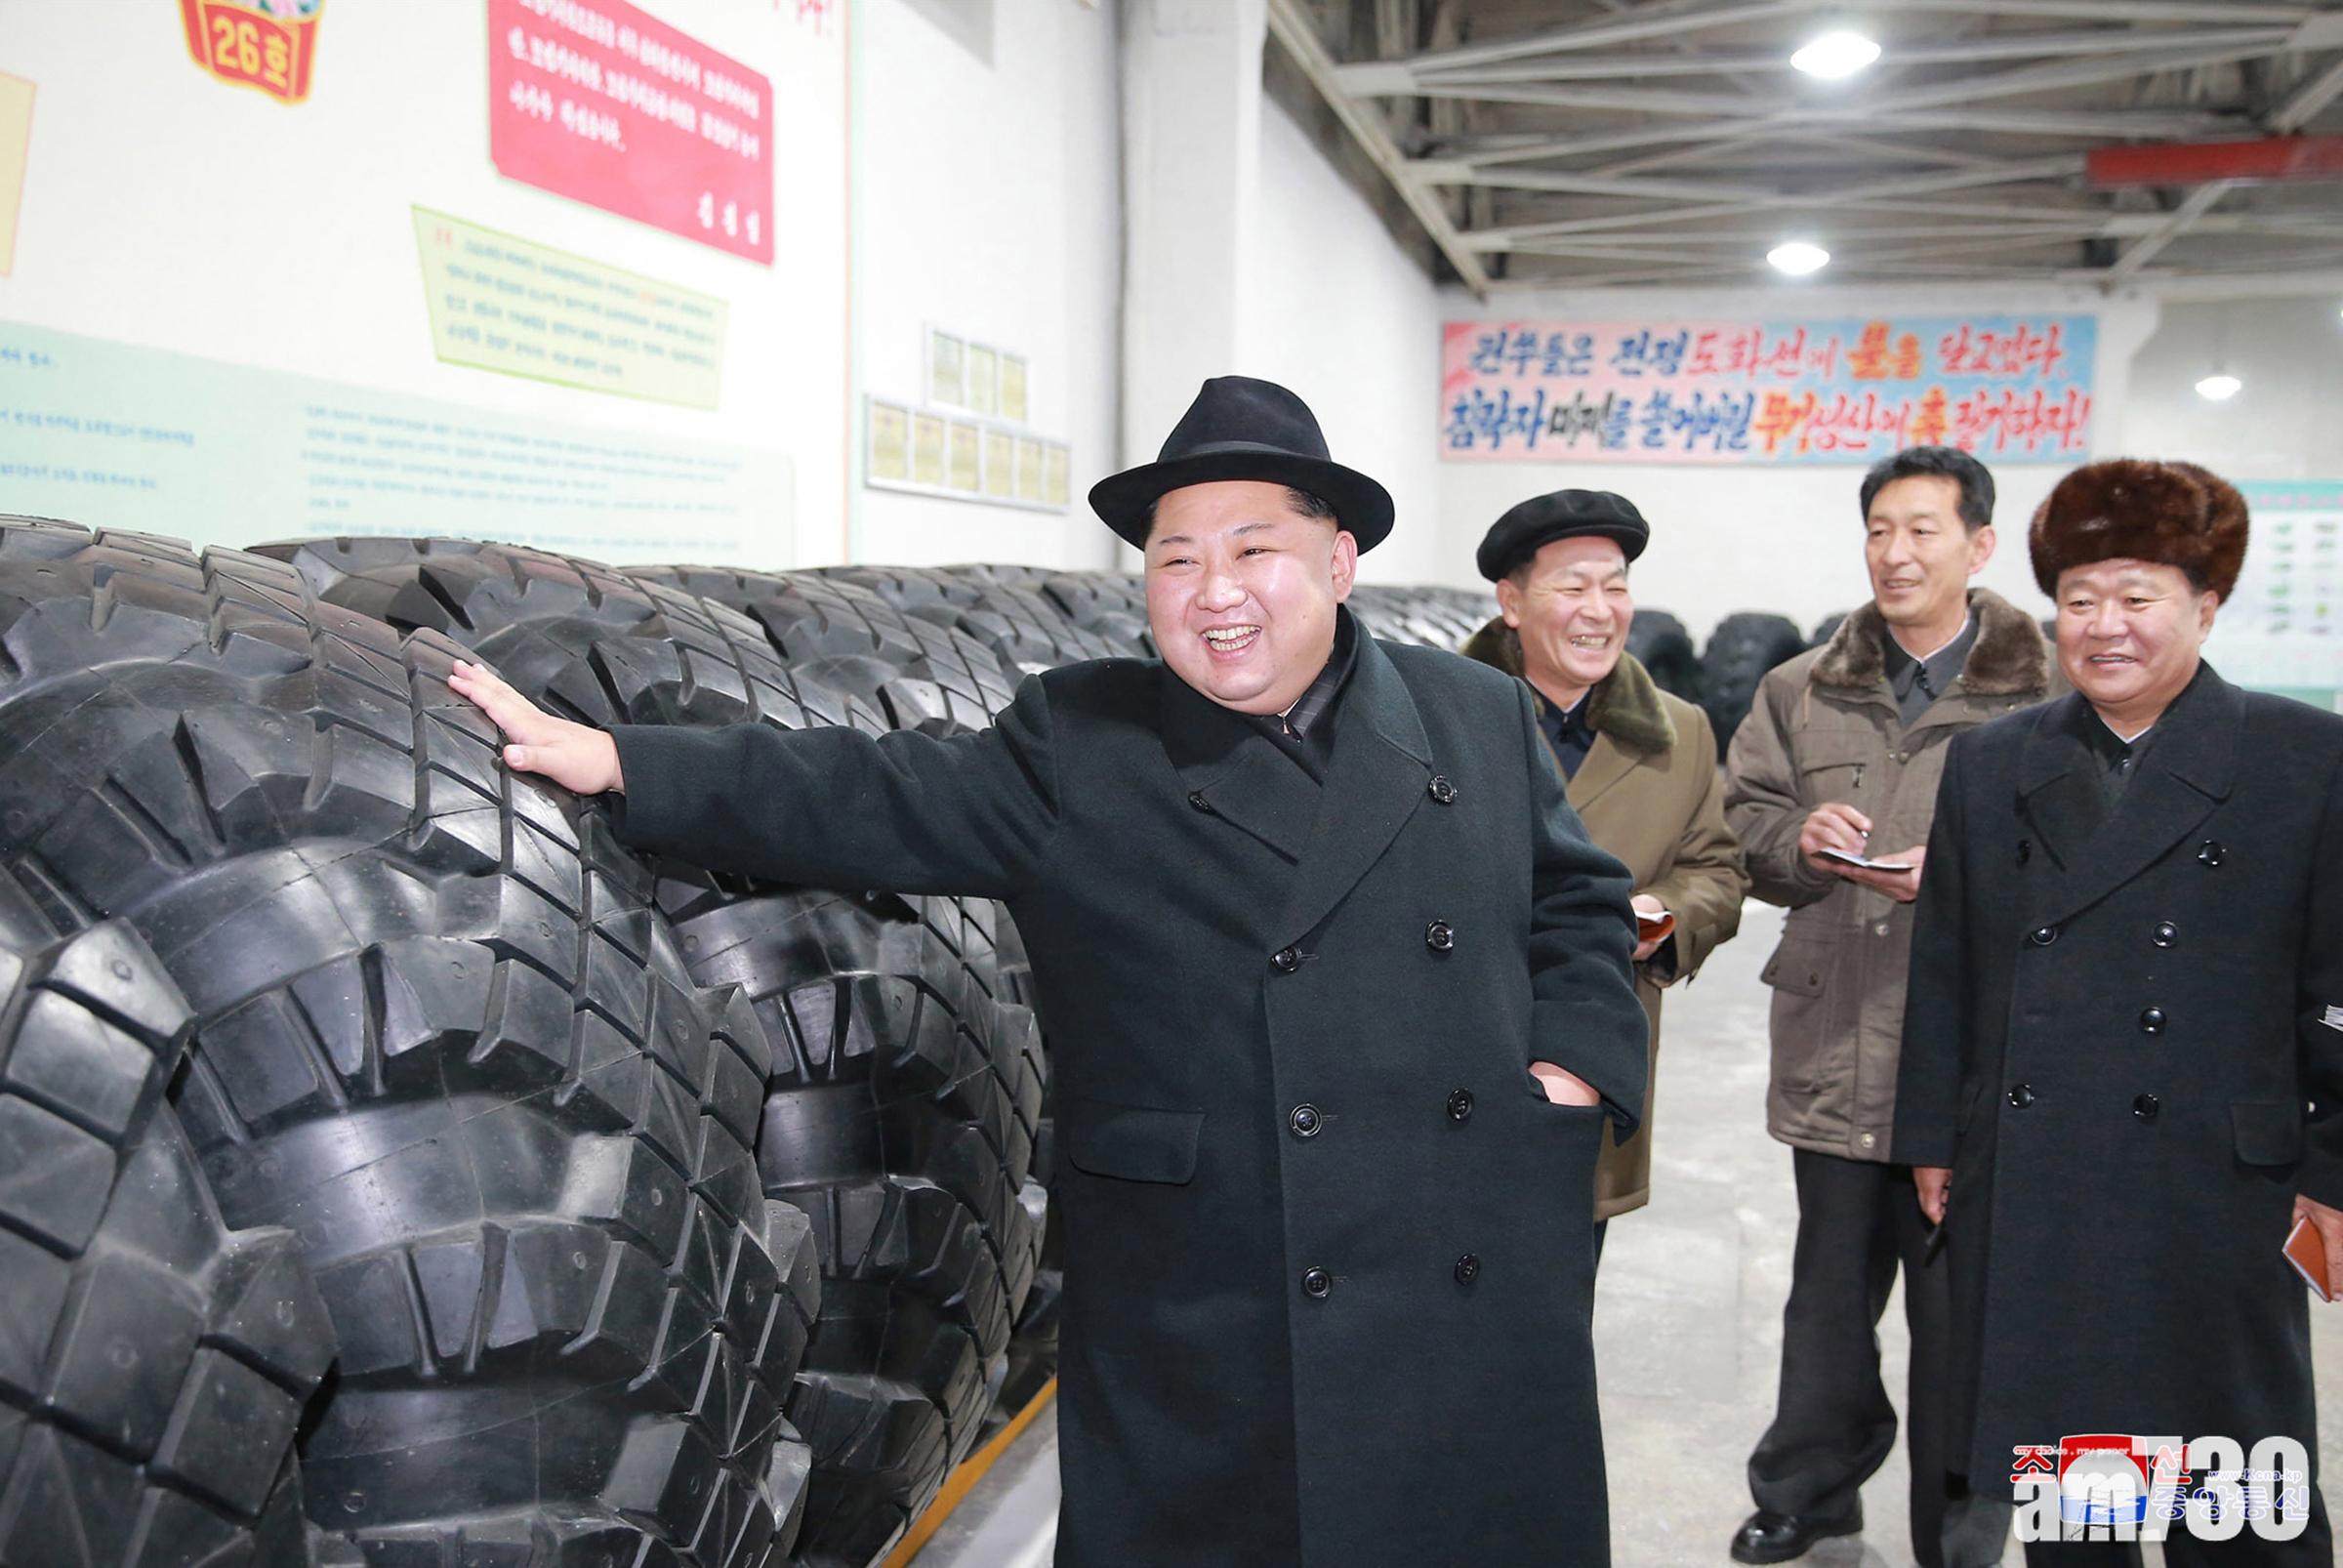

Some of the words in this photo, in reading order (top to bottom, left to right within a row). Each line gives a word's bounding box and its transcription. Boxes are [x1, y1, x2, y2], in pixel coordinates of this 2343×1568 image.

[212, 15, 290, 90] 26호
[1470, 329, 1593, 376] 원쑤들은
[1445, 388, 1544, 450] 침략자
